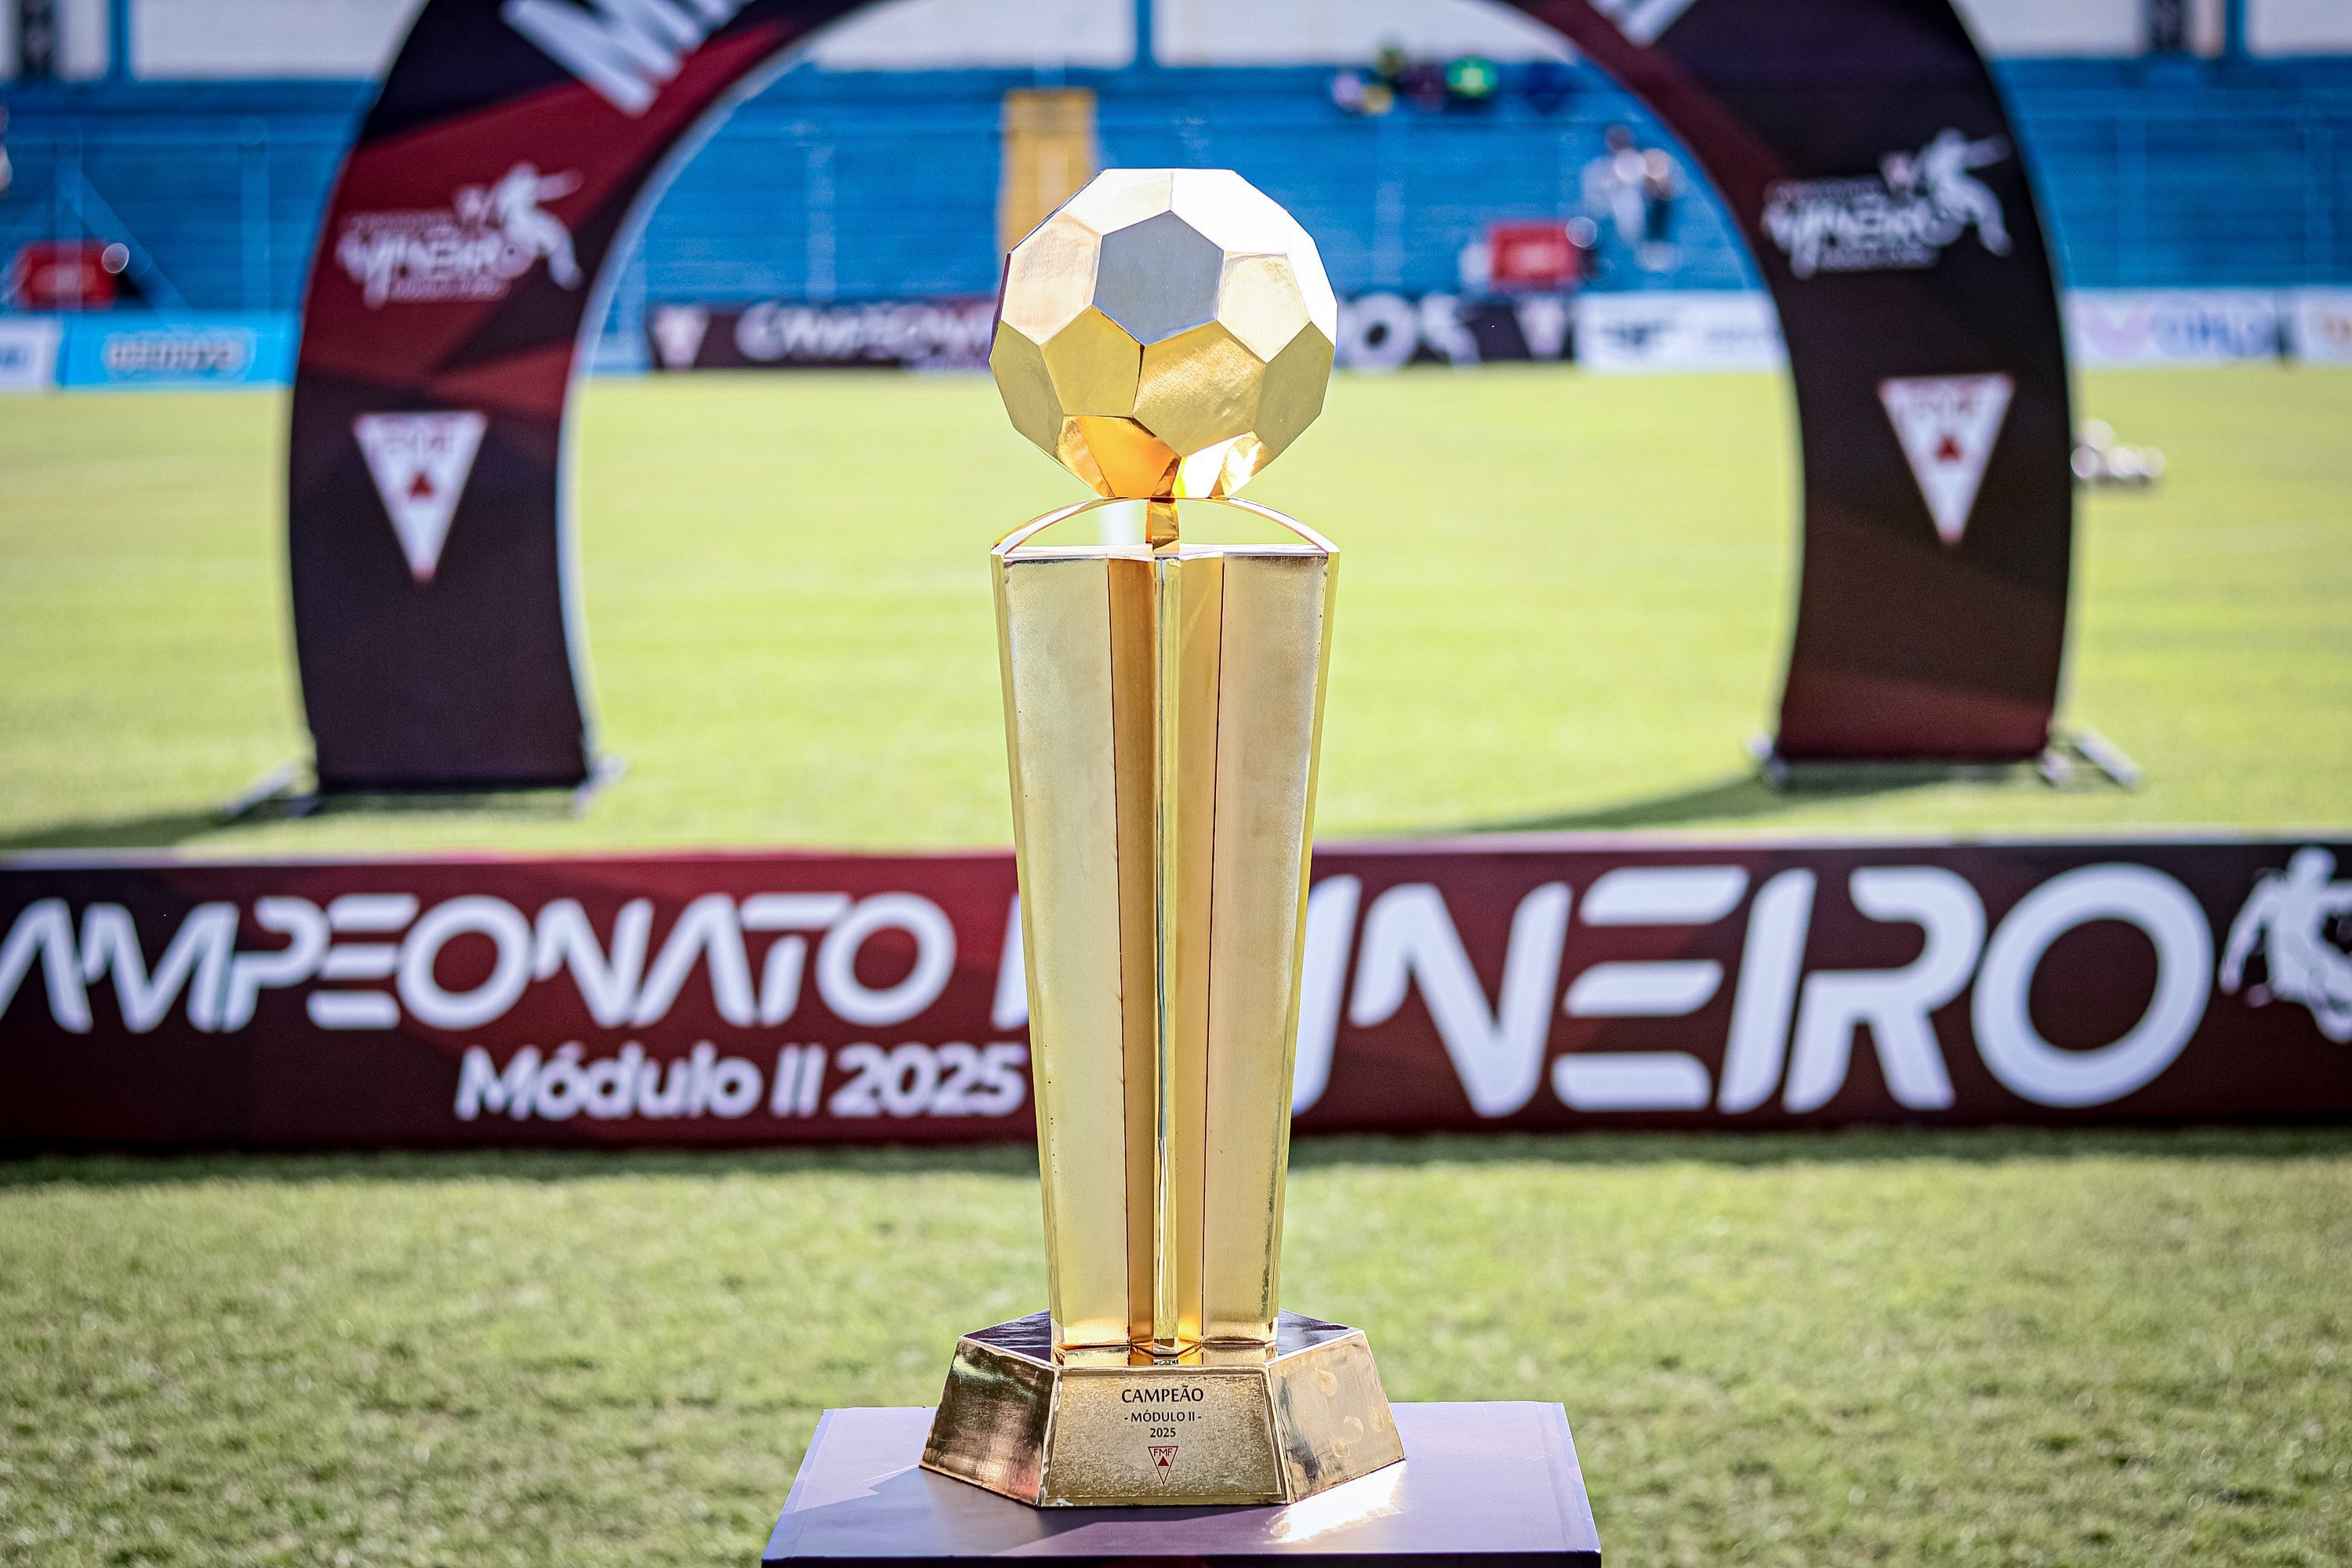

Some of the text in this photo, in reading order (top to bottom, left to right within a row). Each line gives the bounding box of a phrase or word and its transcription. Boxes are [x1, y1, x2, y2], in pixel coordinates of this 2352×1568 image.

[992, 862, 2216, 1117] INEIRO
[455, 1040, 1027, 1120] Módulo II 2025
[1121, 1385, 1204, 1403] CAMPEÃO
[1149, 1428, 1176, 1438] 2025
[1153, 1447, 1174, 1457] FMF
